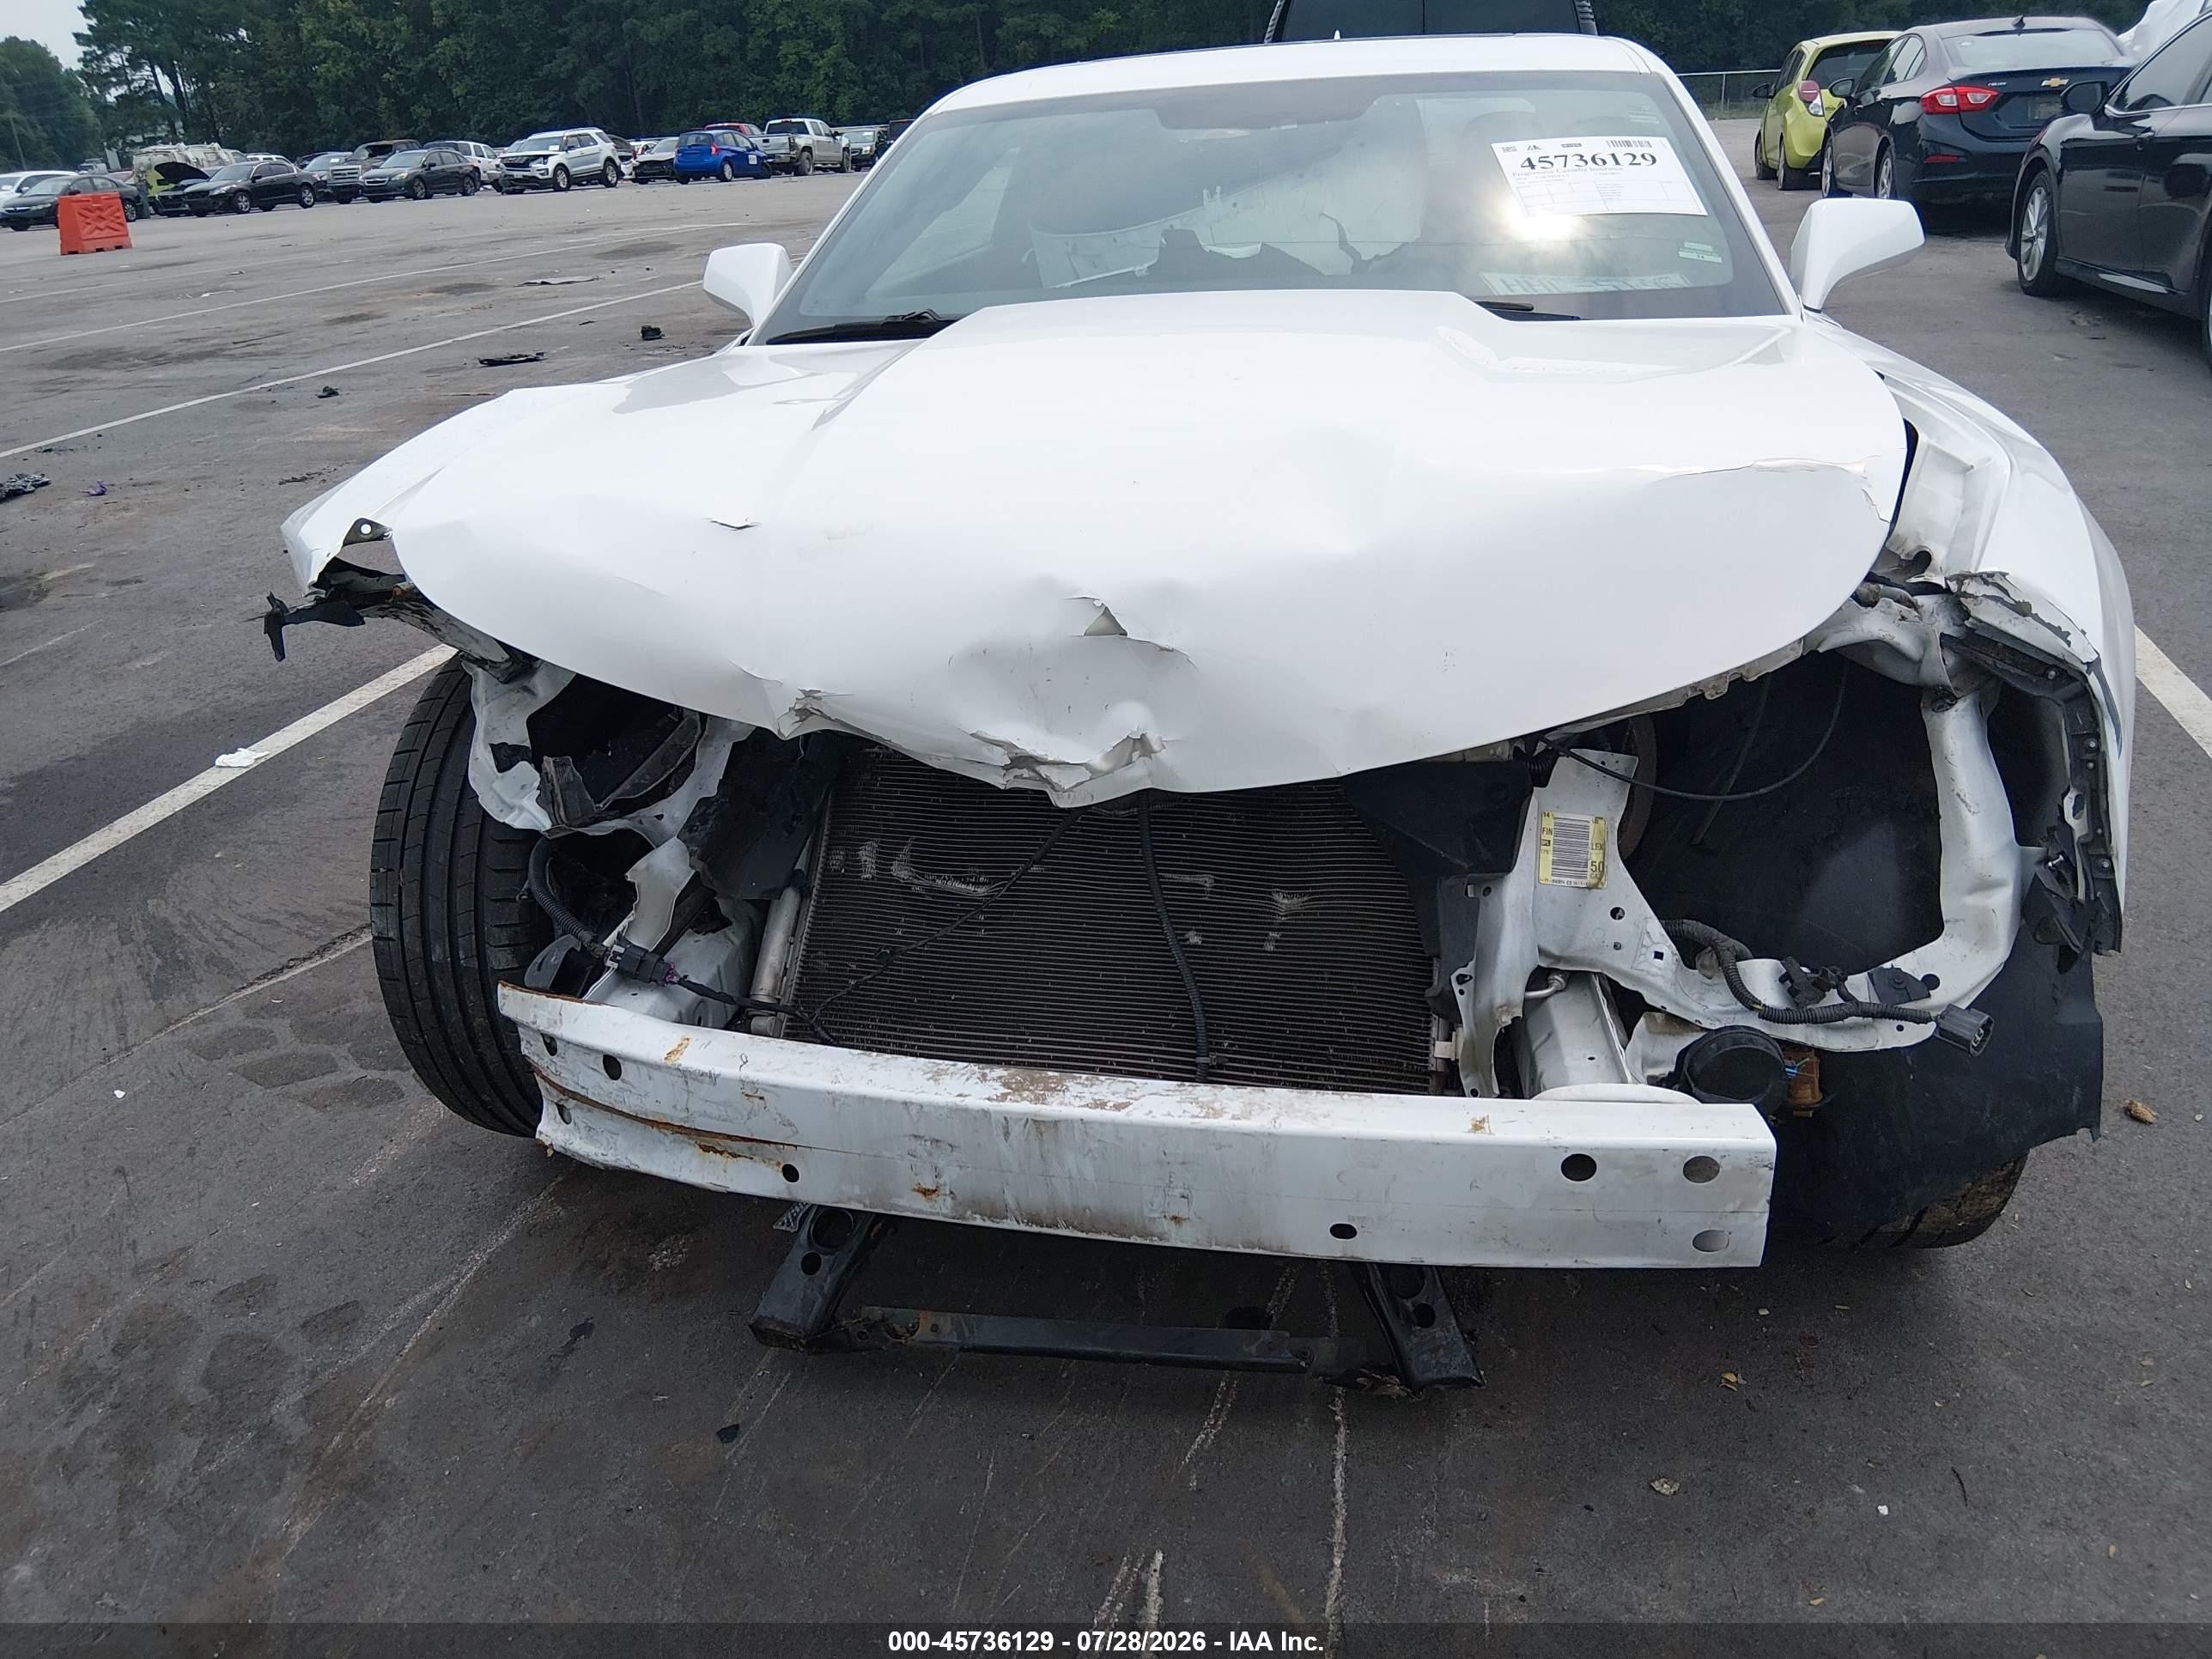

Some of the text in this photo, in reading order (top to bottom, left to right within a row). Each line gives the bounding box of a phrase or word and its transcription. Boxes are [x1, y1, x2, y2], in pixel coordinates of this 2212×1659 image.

[1520, 152, 1657, 171] 45736129
[1541, 827, 1553, 836] FIN
[1590, 860, 1605, 873] 50
